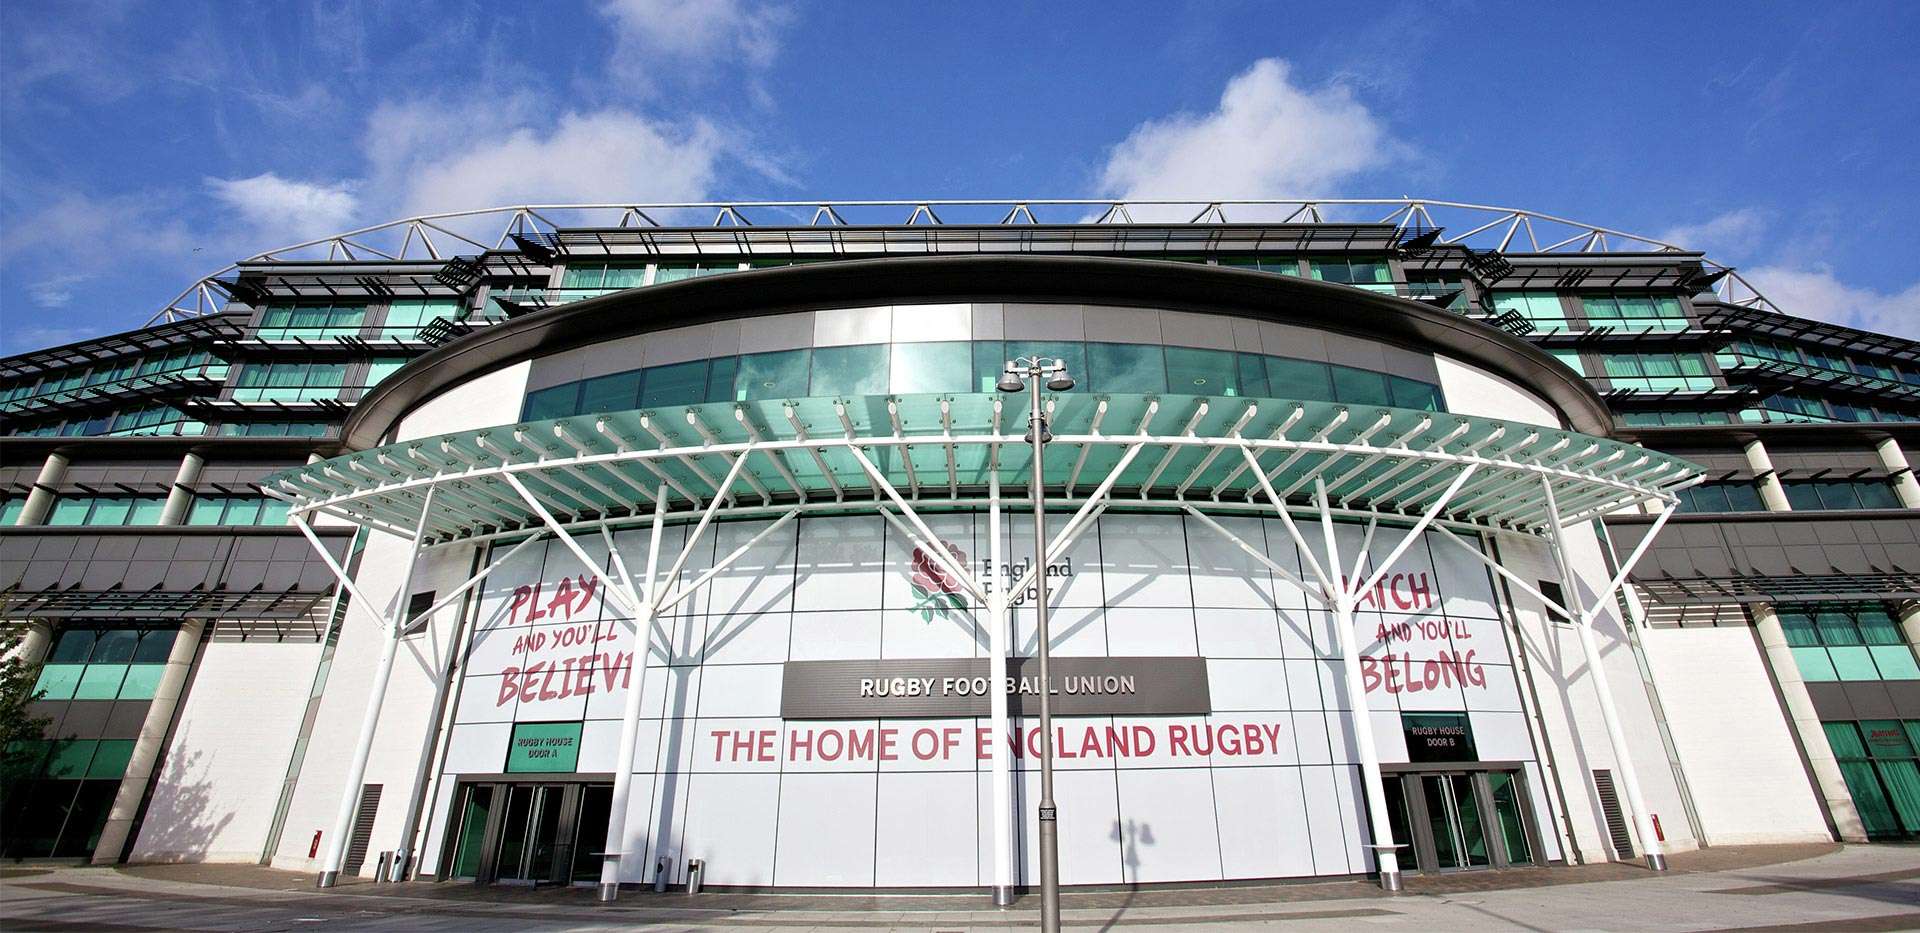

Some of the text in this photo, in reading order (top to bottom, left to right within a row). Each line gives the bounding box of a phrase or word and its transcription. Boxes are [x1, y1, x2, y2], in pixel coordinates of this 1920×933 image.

[982, 557, 1073, 582] Englnd
[509, 574, 598, 625] PLAY
[512, 619, 618, 656] AND YOU'LL
[1376, 620, 1472, 644] AND YOU'LL
[1359, 649, 1487, 694] BELONG
[861, 675, 1136, 697] RUGBY FOOBALL UNION
[518, 736, 574, 747] RUGBY HOUSE
[711, 730, 777, 761] THE
[789, 728, 899, 761] HOME
[911, 727, 962, 760] OF
[1168, 723, 1281, 757] RUGBY
[1412, 726, 1465, 736] RUGBY HOUSE
[1427, 737, 1456, 747] DOOR B
[528, 748, 558, 759] DOOR A
